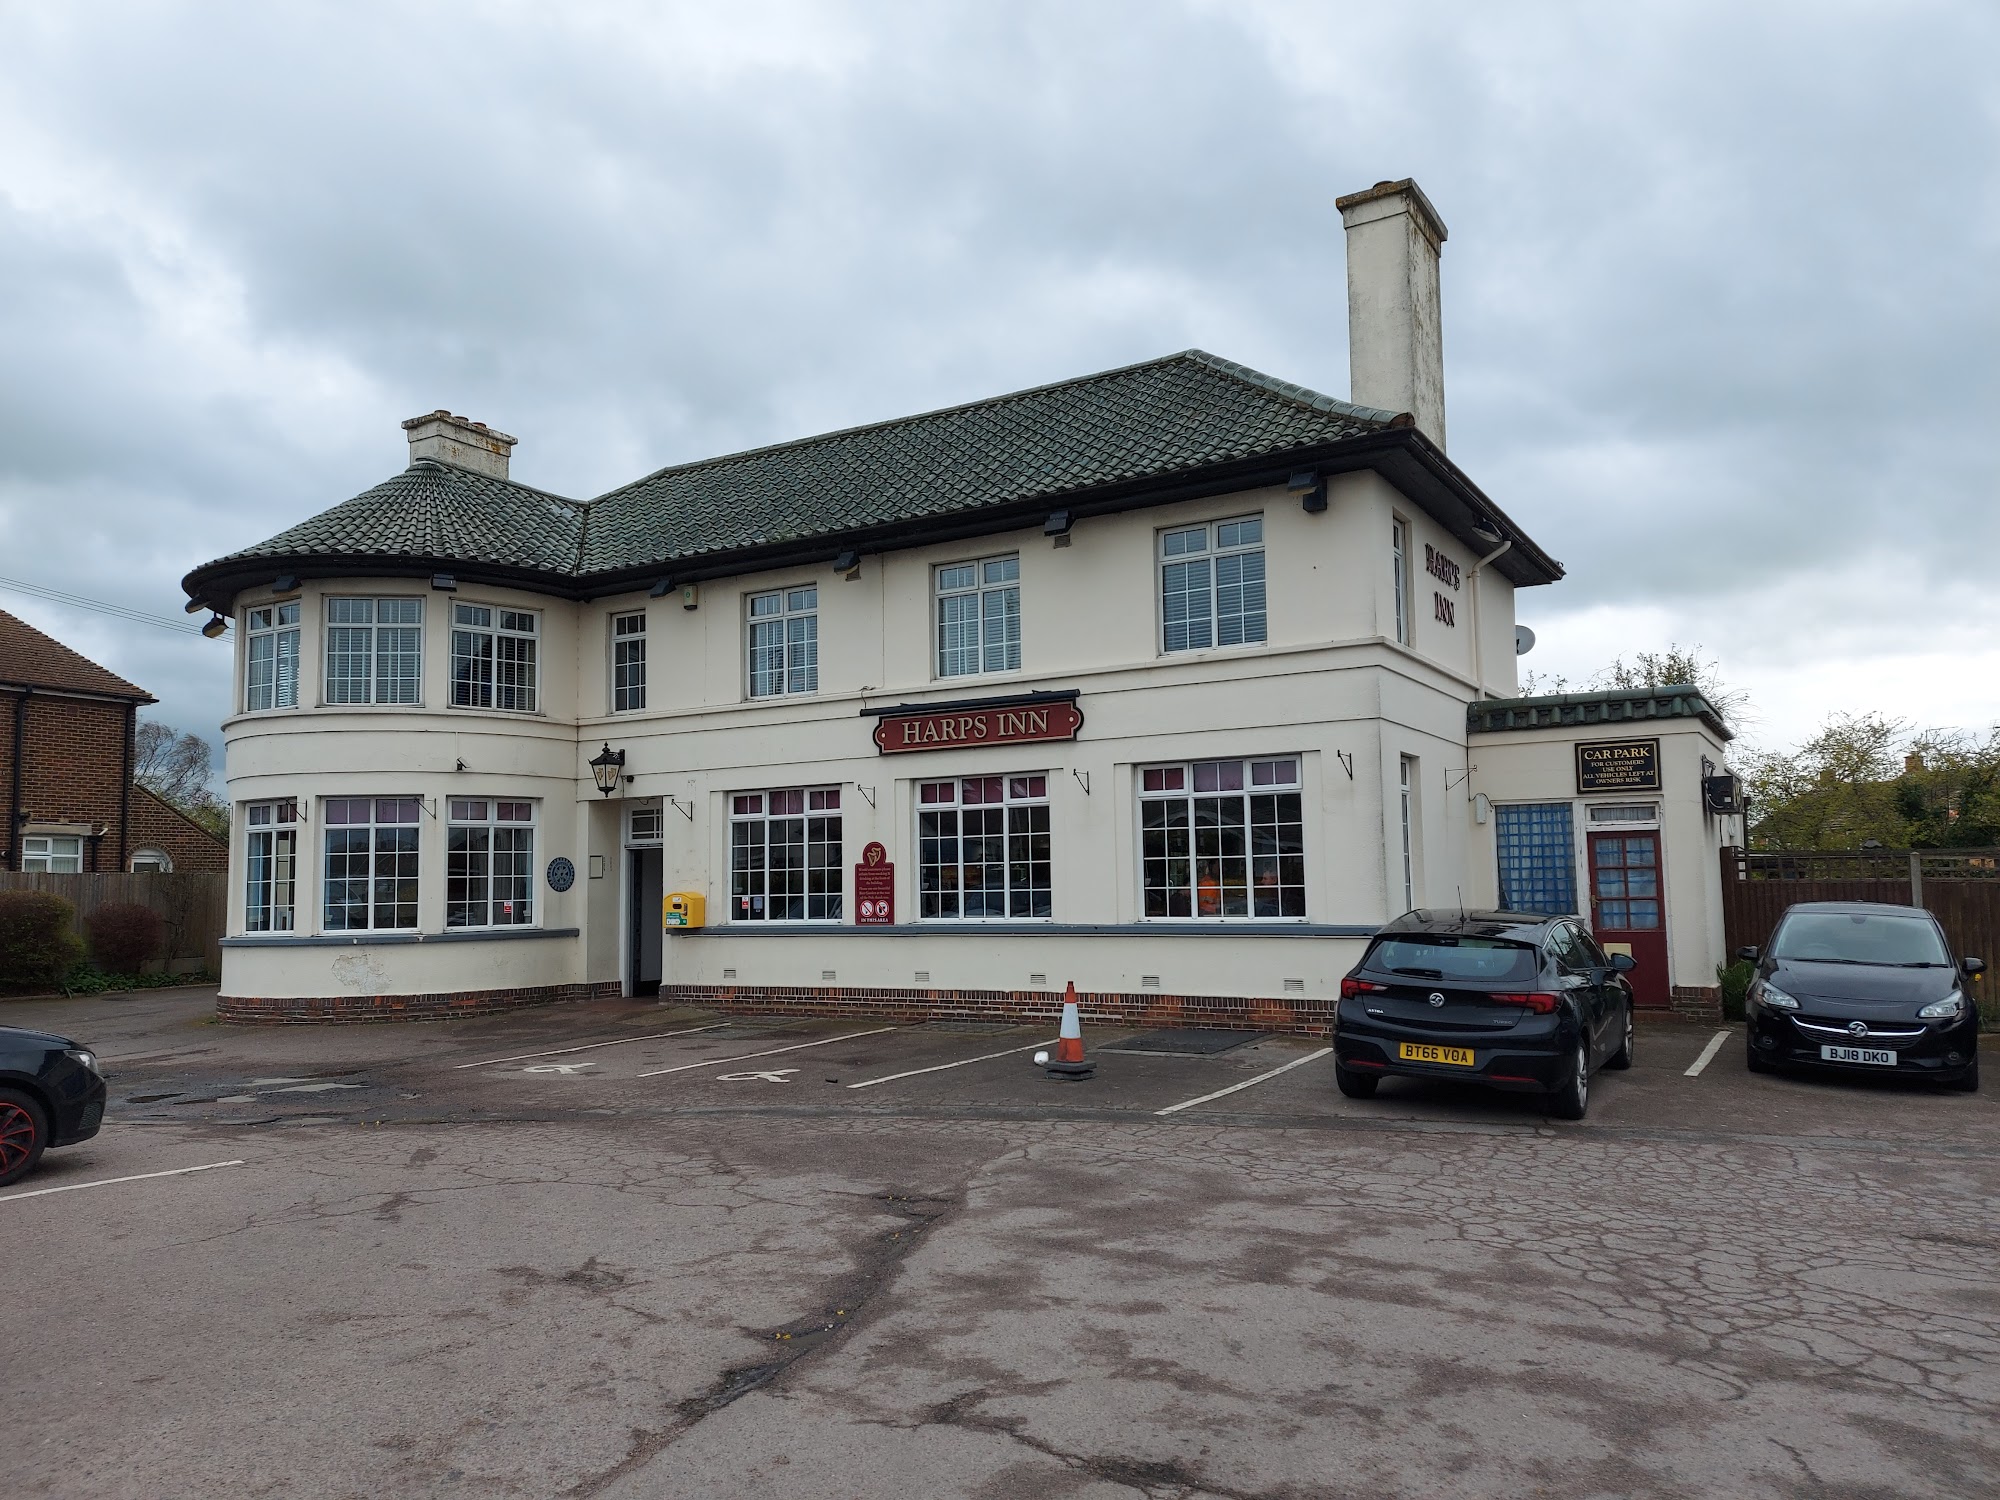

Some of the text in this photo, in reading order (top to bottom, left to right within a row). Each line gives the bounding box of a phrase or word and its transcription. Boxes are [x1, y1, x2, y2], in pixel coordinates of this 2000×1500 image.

[1434, 591, 1455, 629] INN
[902, 710, 1049, 744] HARPS INN
[1584, 747, 1651, 760] CAR PARK
[1605, 759, 1645, 767] CUSTOMERS
[1595, 777, 1625, 785] OWNERS
[1405, 1045, 1469, 1063] BT66 VOA
[1830, 1048, 1889, 1063] BJ18 DKO
